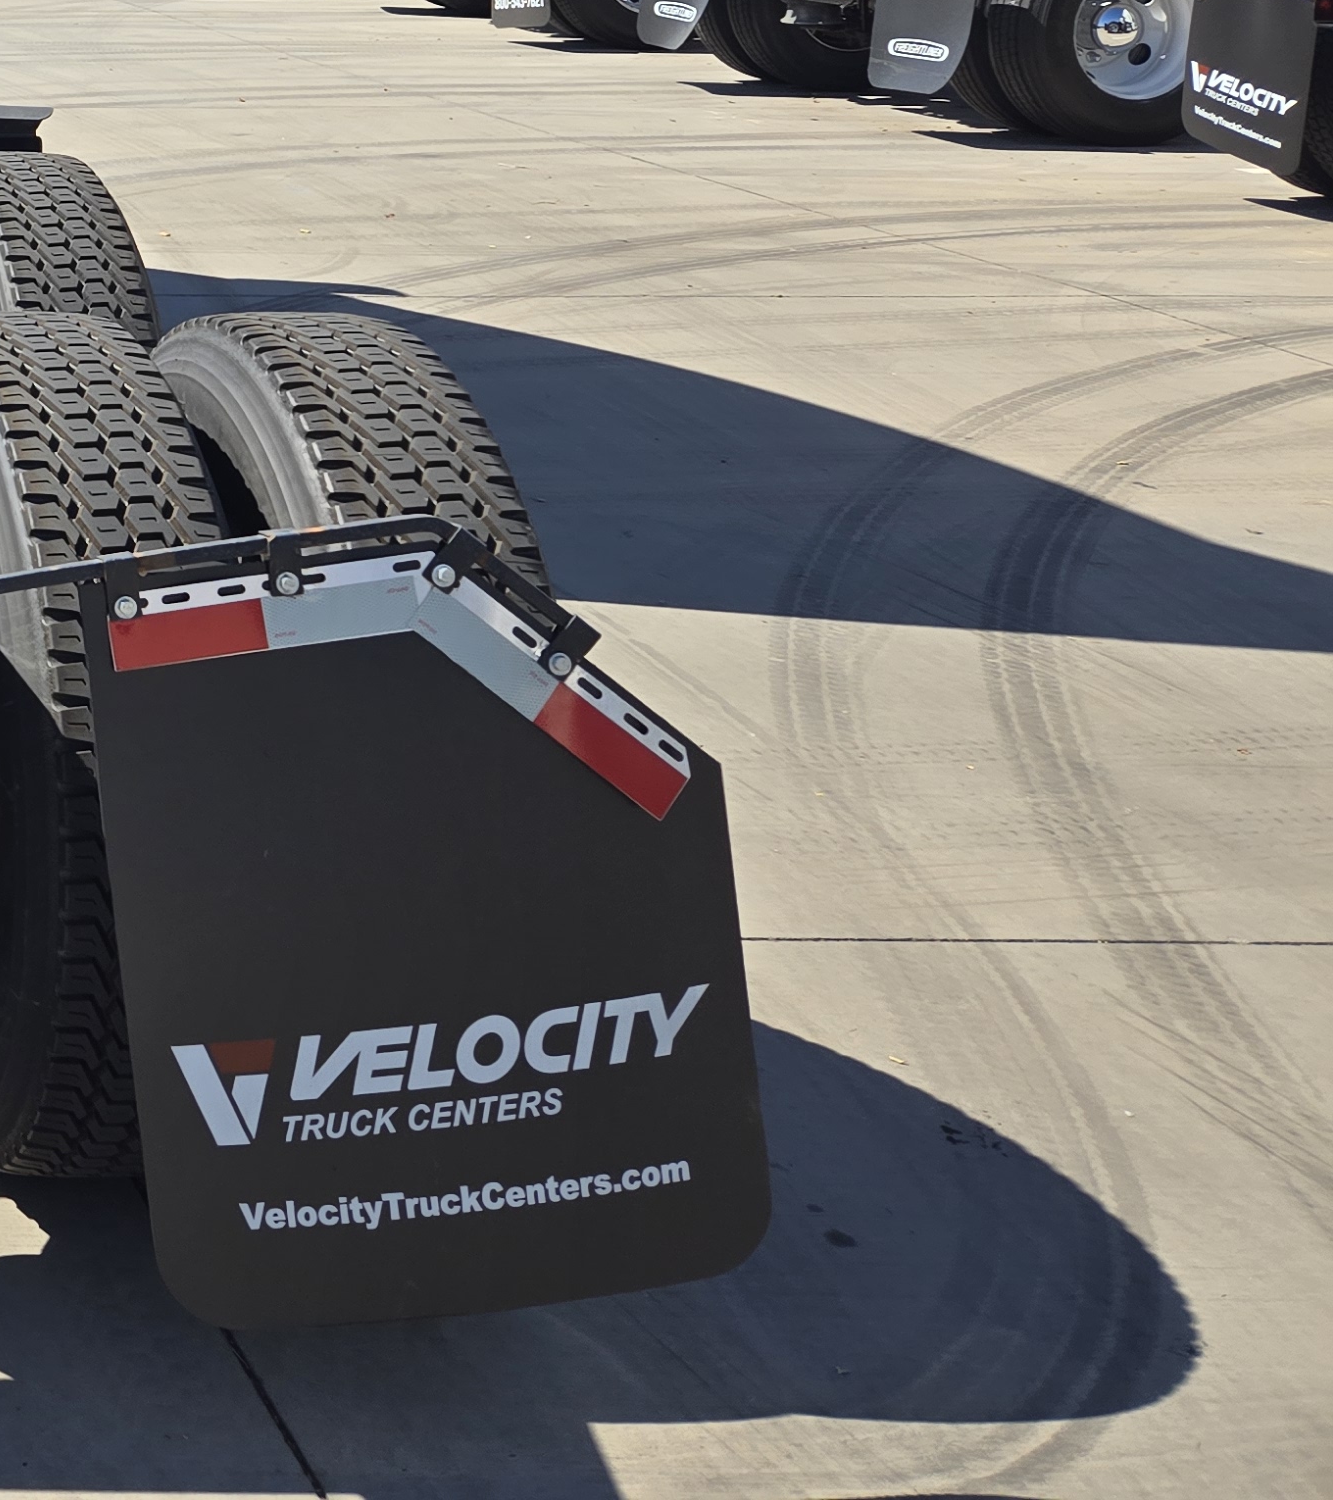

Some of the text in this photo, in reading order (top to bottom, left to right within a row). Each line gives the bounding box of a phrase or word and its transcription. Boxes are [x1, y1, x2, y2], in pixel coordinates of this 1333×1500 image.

[1205, 87, 1259, 117] TRUCK CENTERS
[1208, 69, 1298, 115] VELOCITY
[290, 984, 709, 1101] VELOCITY
[282, 1087, 563, 1142] TRUCK CENTERS
[239, 1161, 691, 1230] VelocityTruckCenters.com
